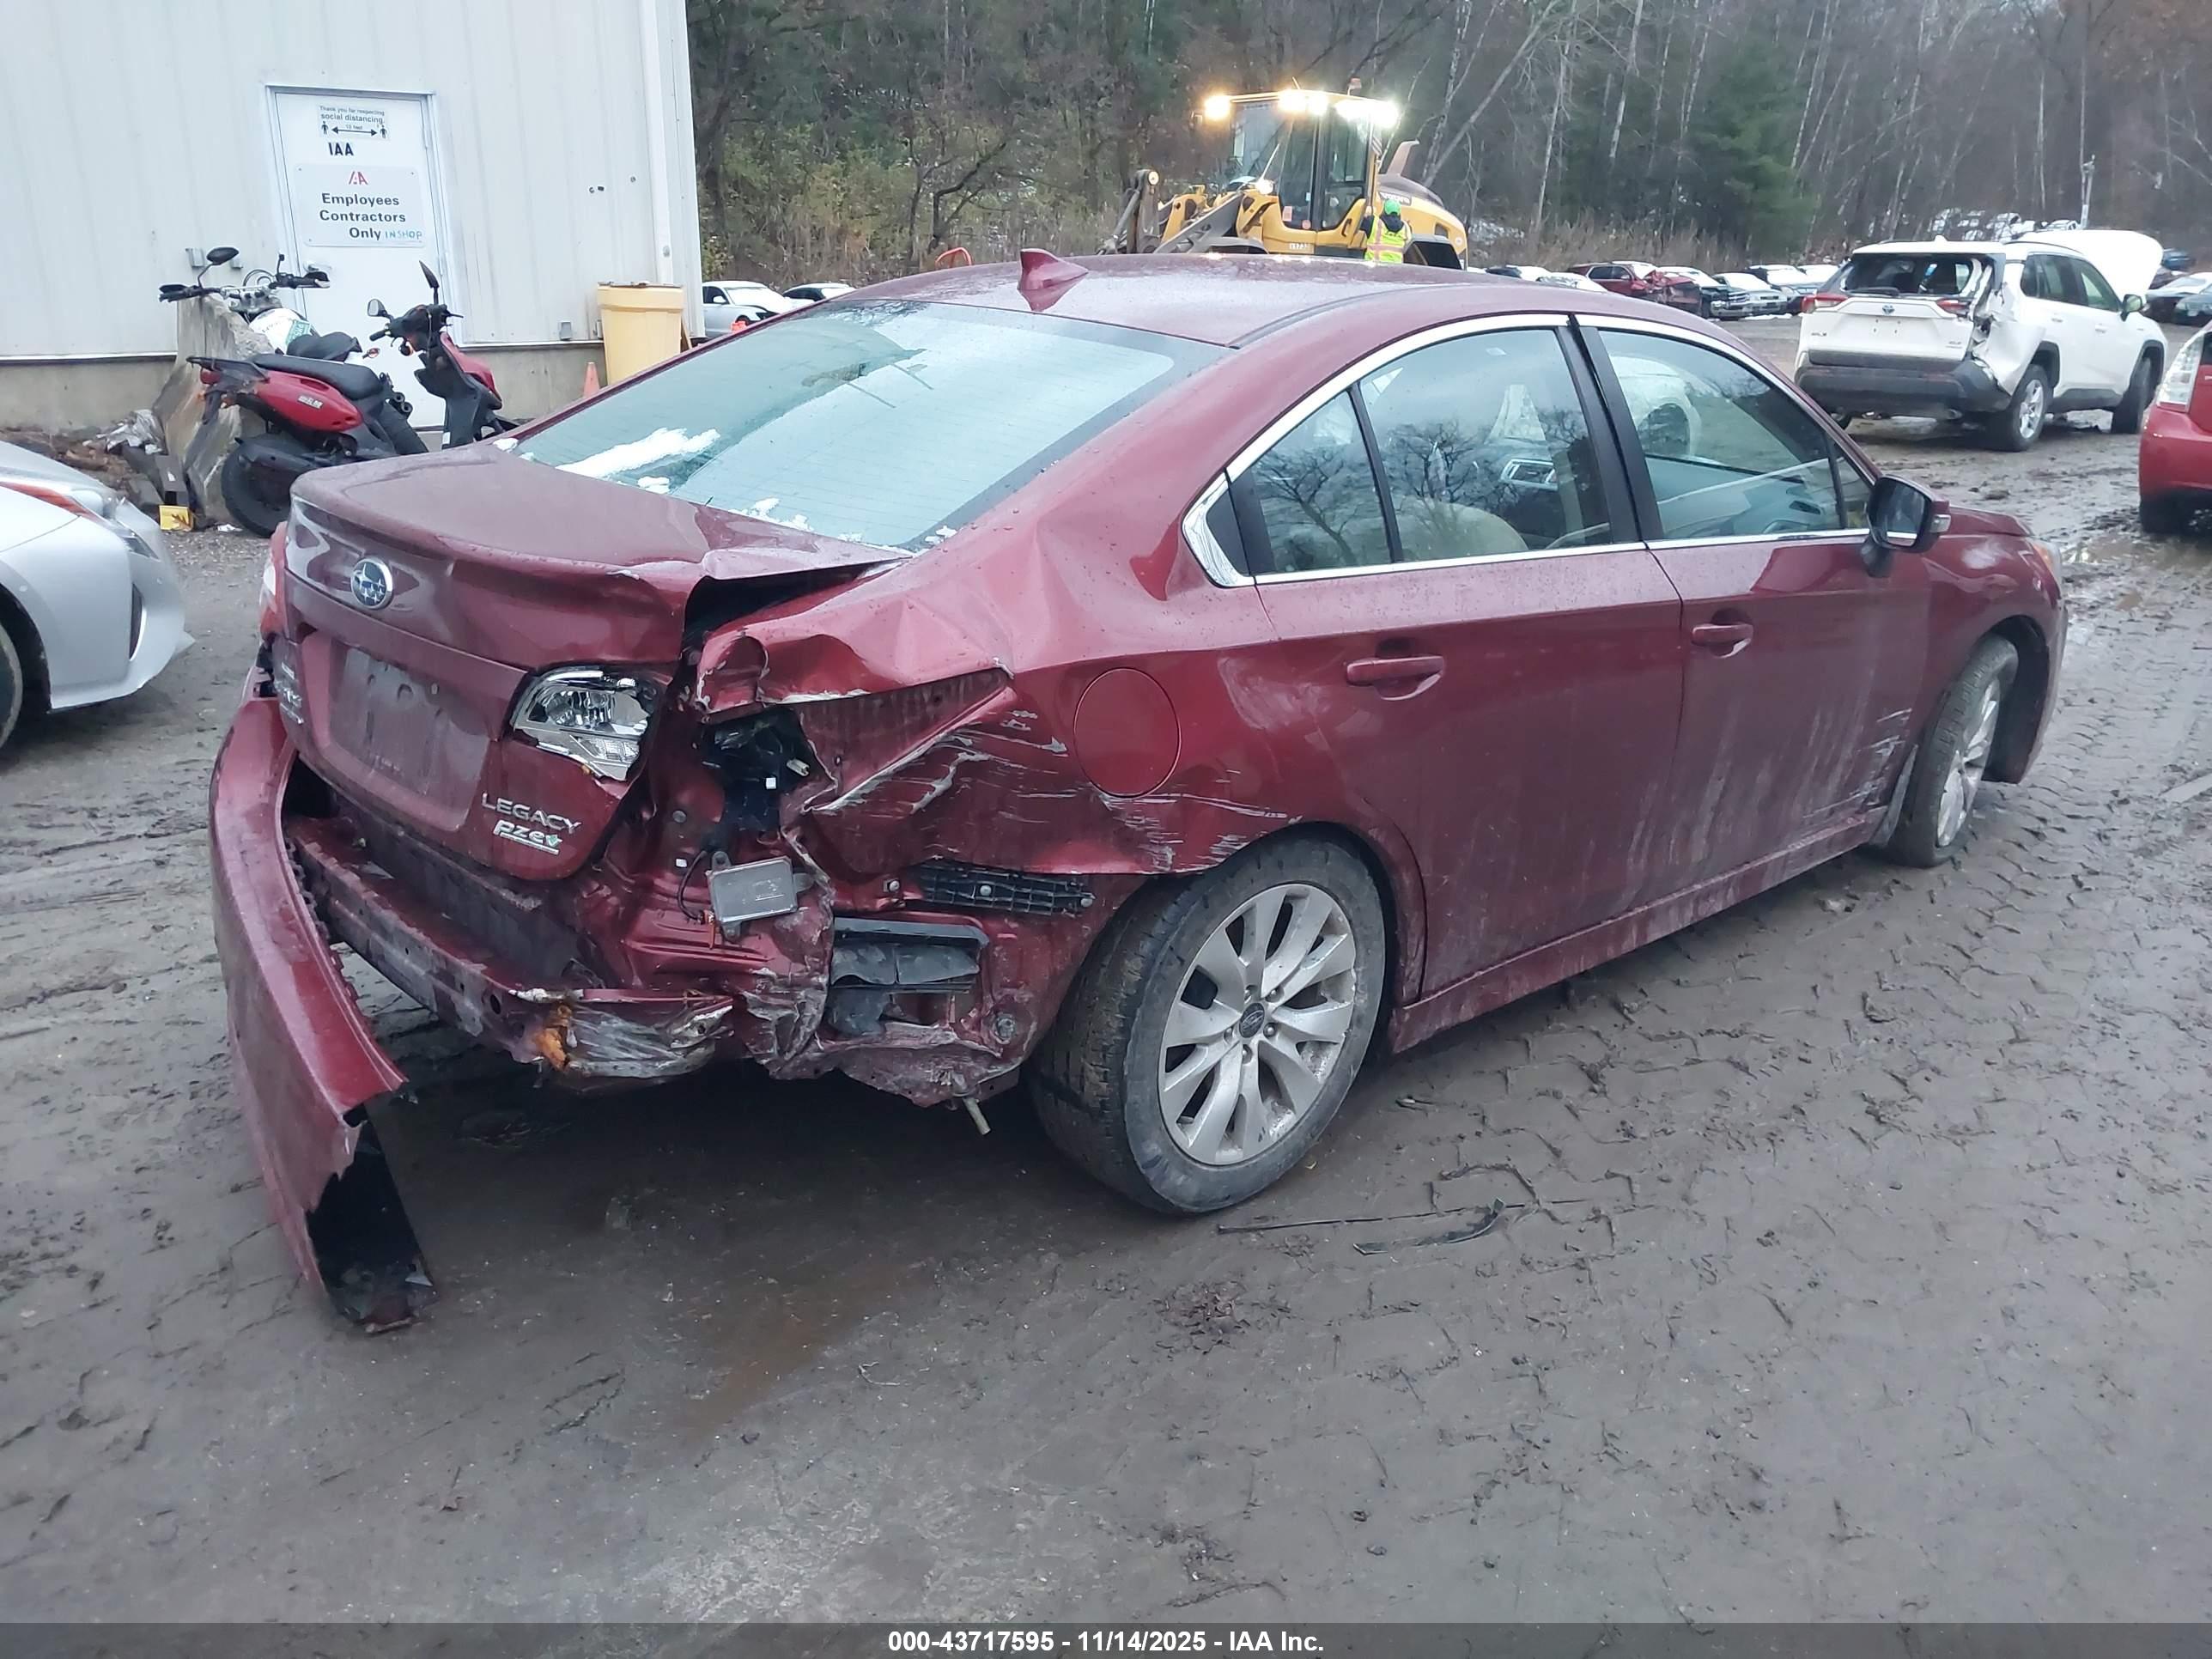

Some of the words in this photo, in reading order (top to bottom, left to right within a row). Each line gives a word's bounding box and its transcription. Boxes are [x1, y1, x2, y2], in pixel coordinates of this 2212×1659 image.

[328, 142, 354, 156] IAA
[322, 193, 399, 207] Employees
[319, 210, 406, 222] Contractors
[349, 227, 381, 240] Only
[481, 792, 583, 835] LEGACY
